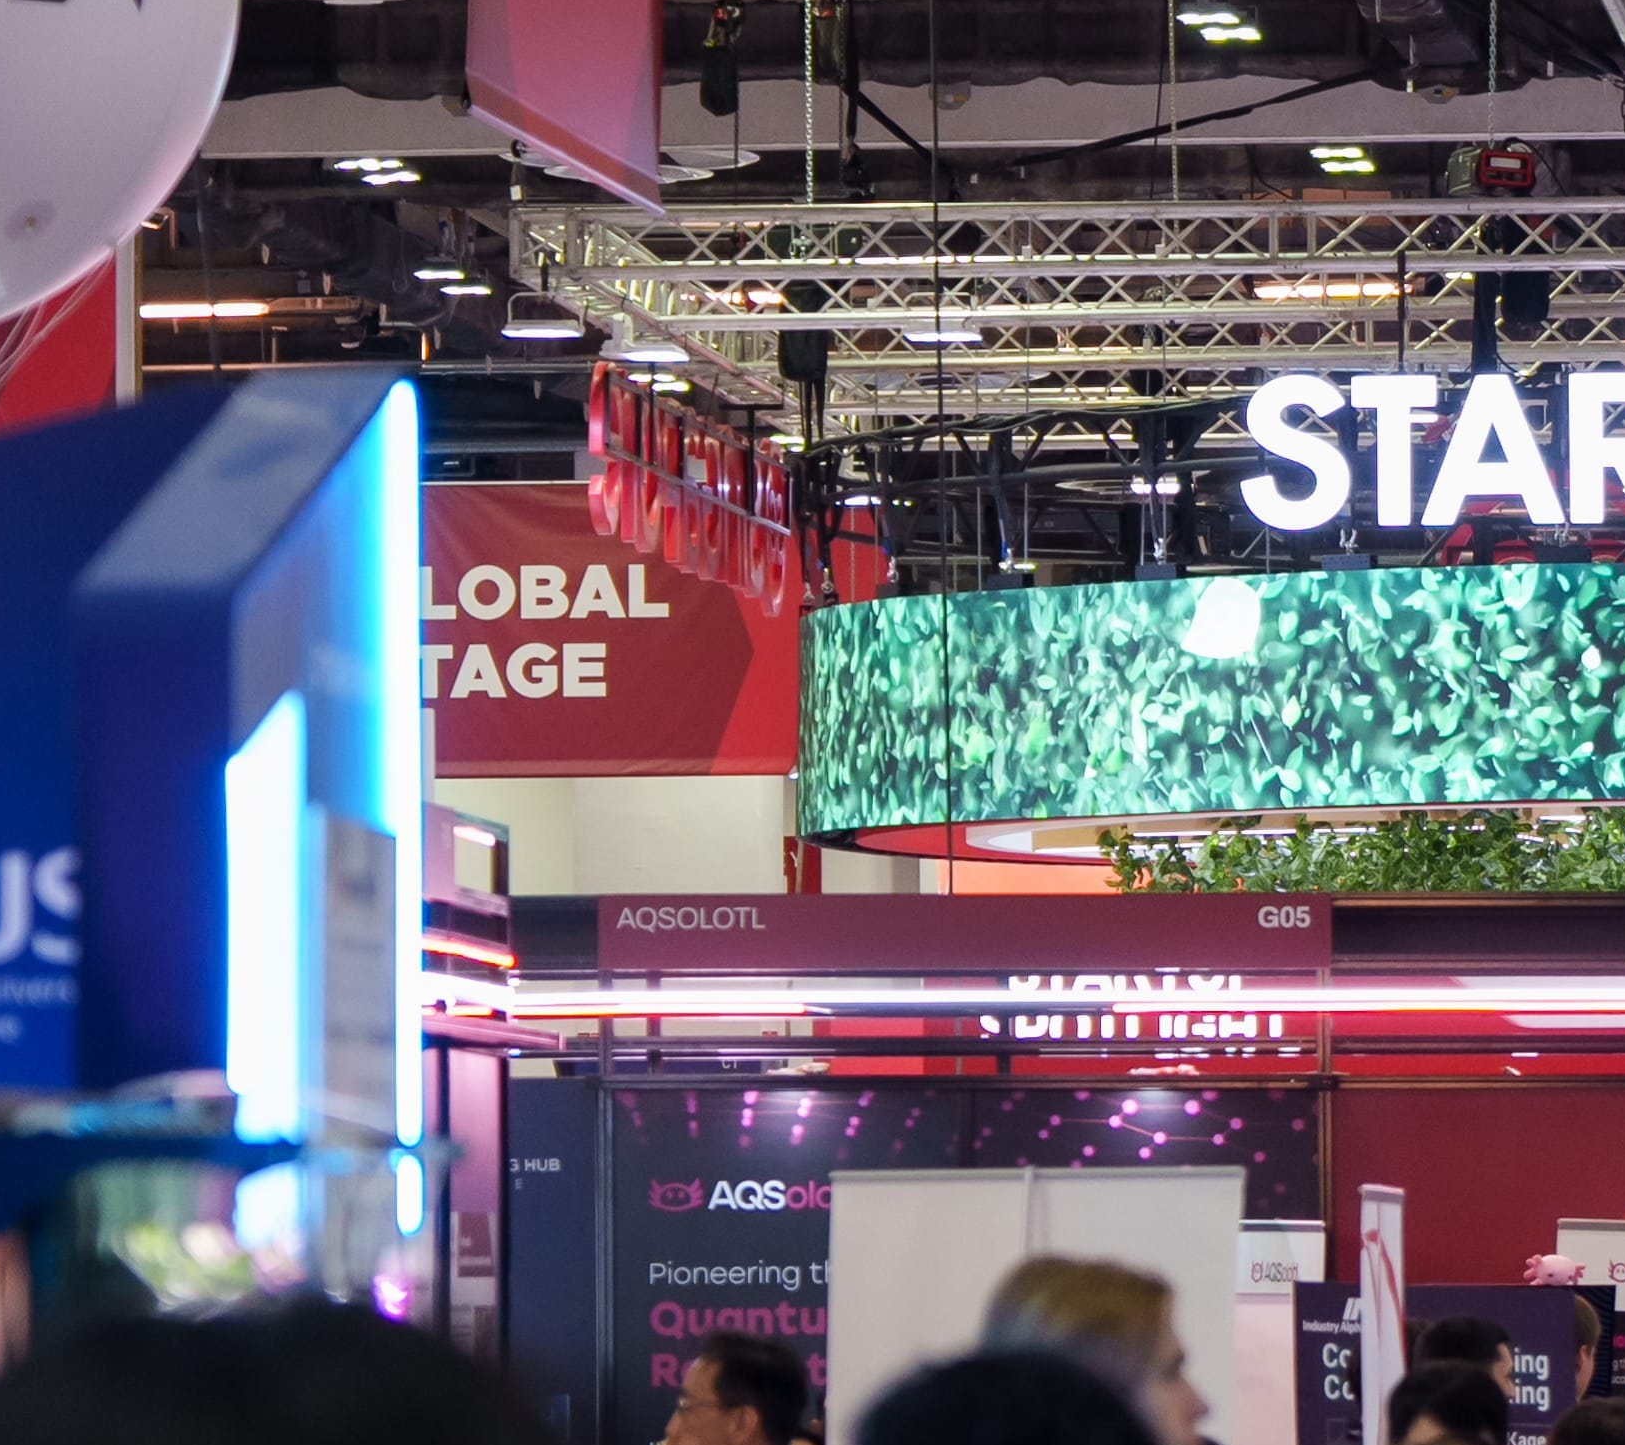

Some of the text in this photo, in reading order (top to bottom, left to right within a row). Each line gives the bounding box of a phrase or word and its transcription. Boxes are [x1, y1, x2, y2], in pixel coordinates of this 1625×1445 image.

[421, 563, 670, 621] LOBAL
[421, 642, 607, 700] TAGE
[616, 906, 766, 932] AQSOLOTL
[1258, 906, 1311, 929] G05
[524, 1157, 561, 1173] HUB
[648, 1260, 801, 1291] Pioneering
[649, 1301, 828, 1339] Quantu
[1340, 1319, 1362, 1335] Alph
